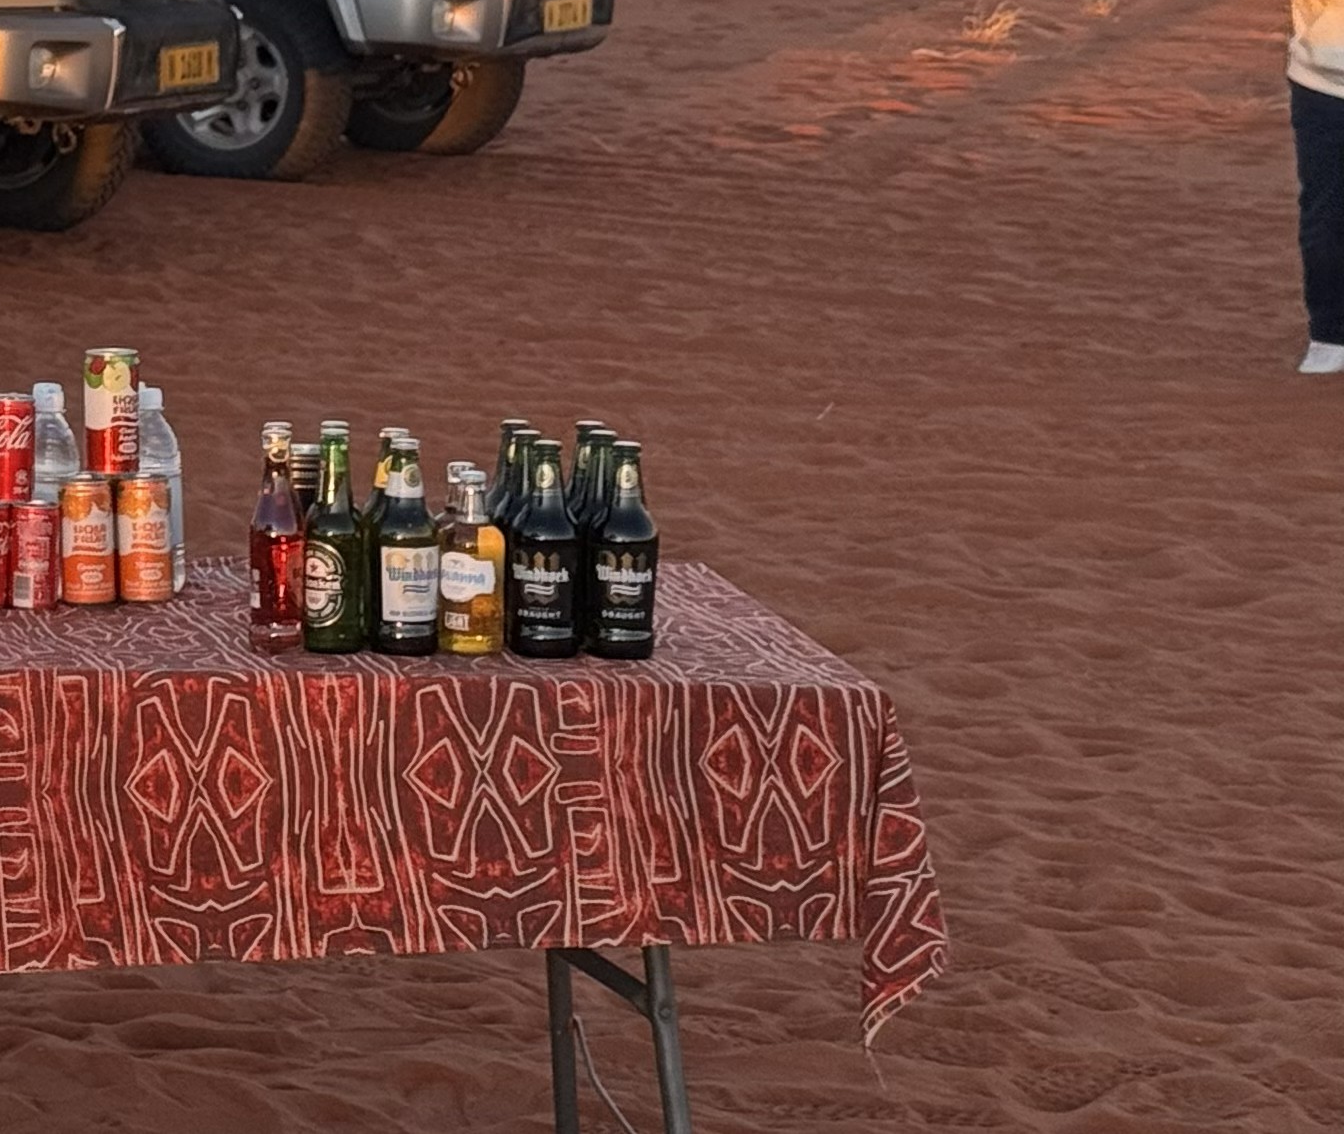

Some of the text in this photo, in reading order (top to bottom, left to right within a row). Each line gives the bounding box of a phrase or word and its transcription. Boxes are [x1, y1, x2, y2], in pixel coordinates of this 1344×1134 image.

[512, 563, 570, 583] Windhoek
[595, 563, 653, 583] Windhoek
[517, 608, 561, 620] DRAUGHT
[601, 609, 646, 620] DRAUGHT
